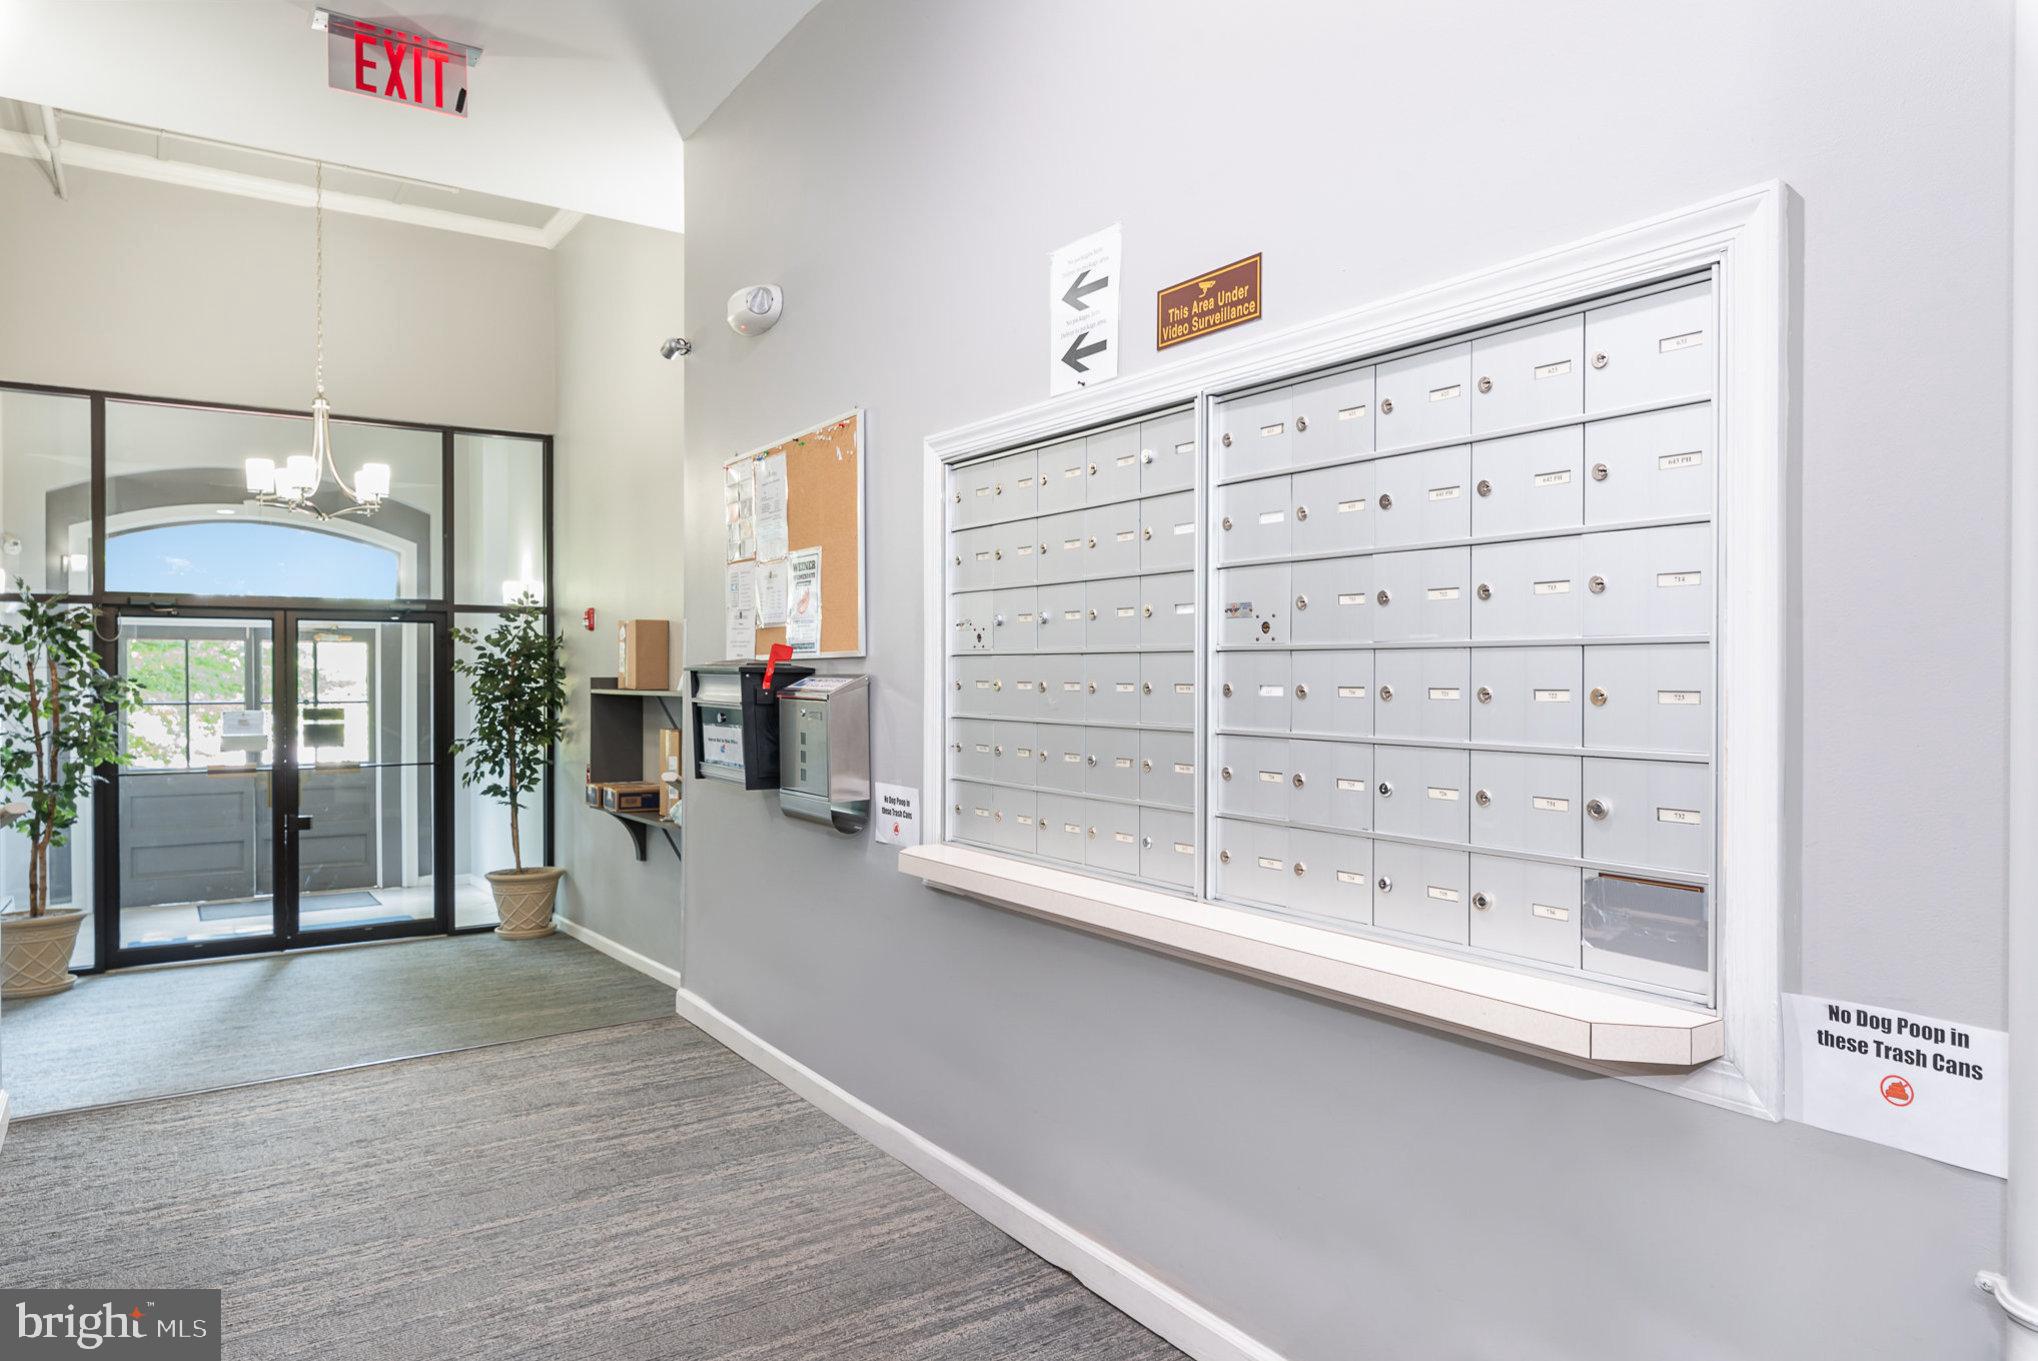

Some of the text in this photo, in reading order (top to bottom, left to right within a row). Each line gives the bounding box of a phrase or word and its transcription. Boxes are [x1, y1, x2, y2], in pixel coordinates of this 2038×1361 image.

[354, 32, 449, 108] EXIT
[1162, 300, 1256, 340] Video Surveillance
[1168, 284, 1249, 322] This Area Under
[1828, 1004, 1970, 1049] No Dog Poop in
[1817, 1029, 1984, 1081] these Trash Cans
